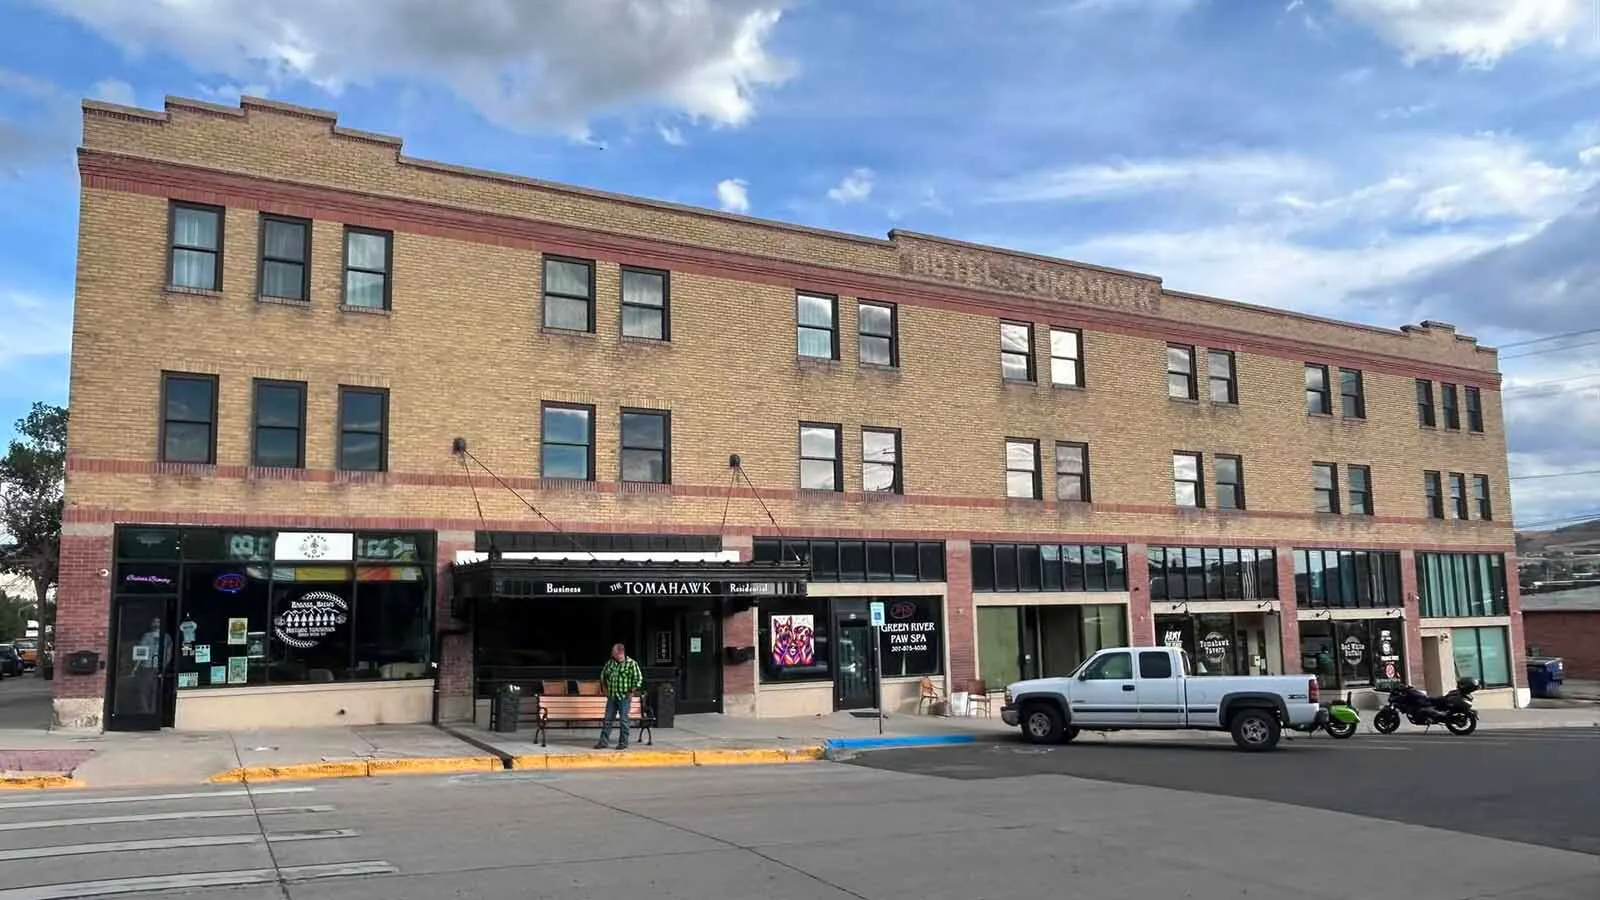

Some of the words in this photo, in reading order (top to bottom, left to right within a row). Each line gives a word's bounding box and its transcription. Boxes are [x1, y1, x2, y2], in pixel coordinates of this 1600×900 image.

[546, 583, 581, 593] Business
[624, 582, 712, 594] TOMAHAWK
[880, 623, 909, 632] GREEN
[911, 622, 935, 631] RIVER
[890, 634, 909, 644] PAW
[910, 633, 927, 643] SPA
[1200, 640, 1229, 648] Tomahawk
